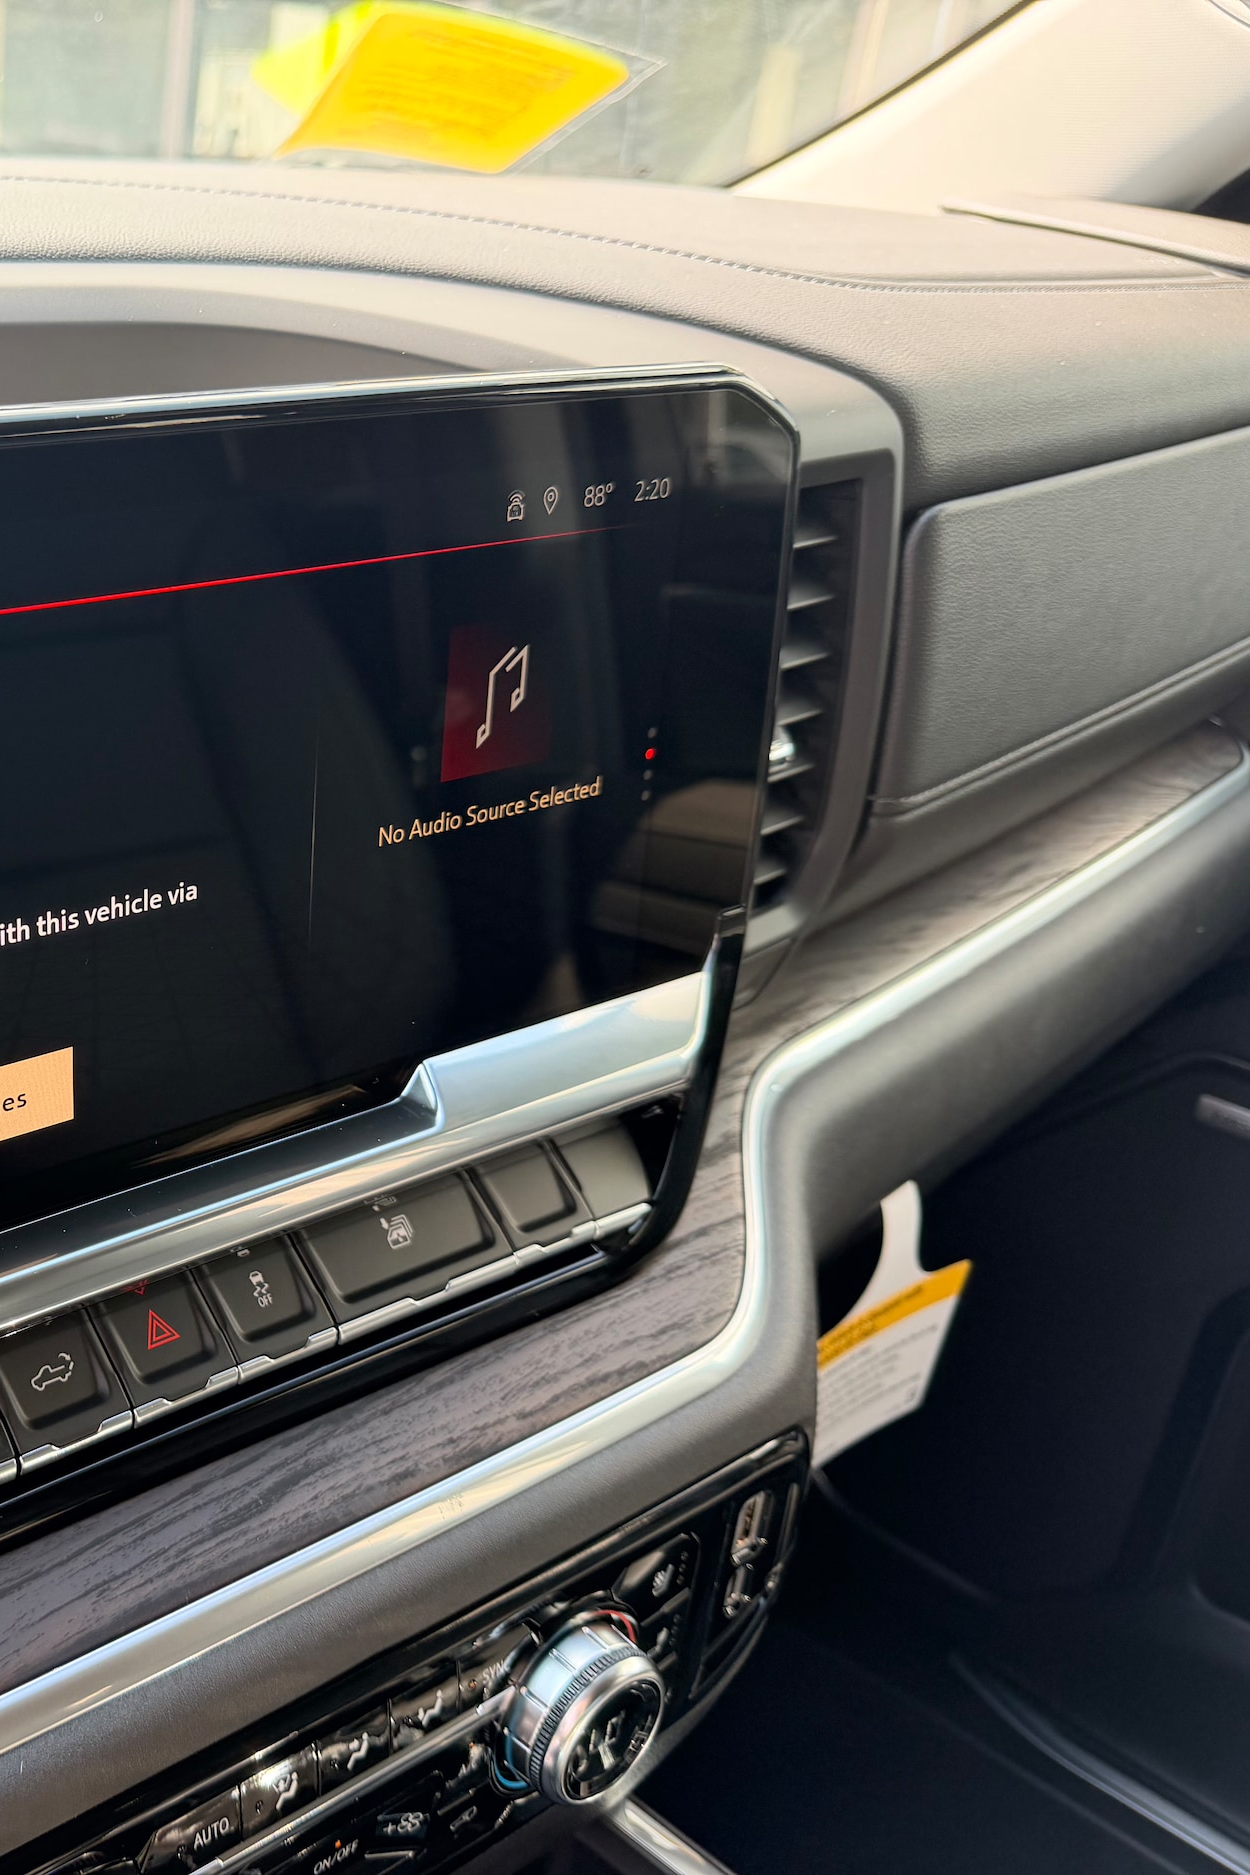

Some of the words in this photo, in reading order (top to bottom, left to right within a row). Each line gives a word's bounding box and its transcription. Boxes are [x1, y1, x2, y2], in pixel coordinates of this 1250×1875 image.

[634, 477, 671, 502] 2:20
[378, 825, 405, 847] No
[408, 812, 462, 840] Audio
[465, 805, 527, 827] Source
[529, 775, 603, 811] Selected
[36, 909, 80, 937] this
[84, 888, 163, 925] vehicle
[167, 881, 199, 906] via
[193, 1816, 230, 1850] AUTO
[313, 1838, 359, 1875] ON/OFF
